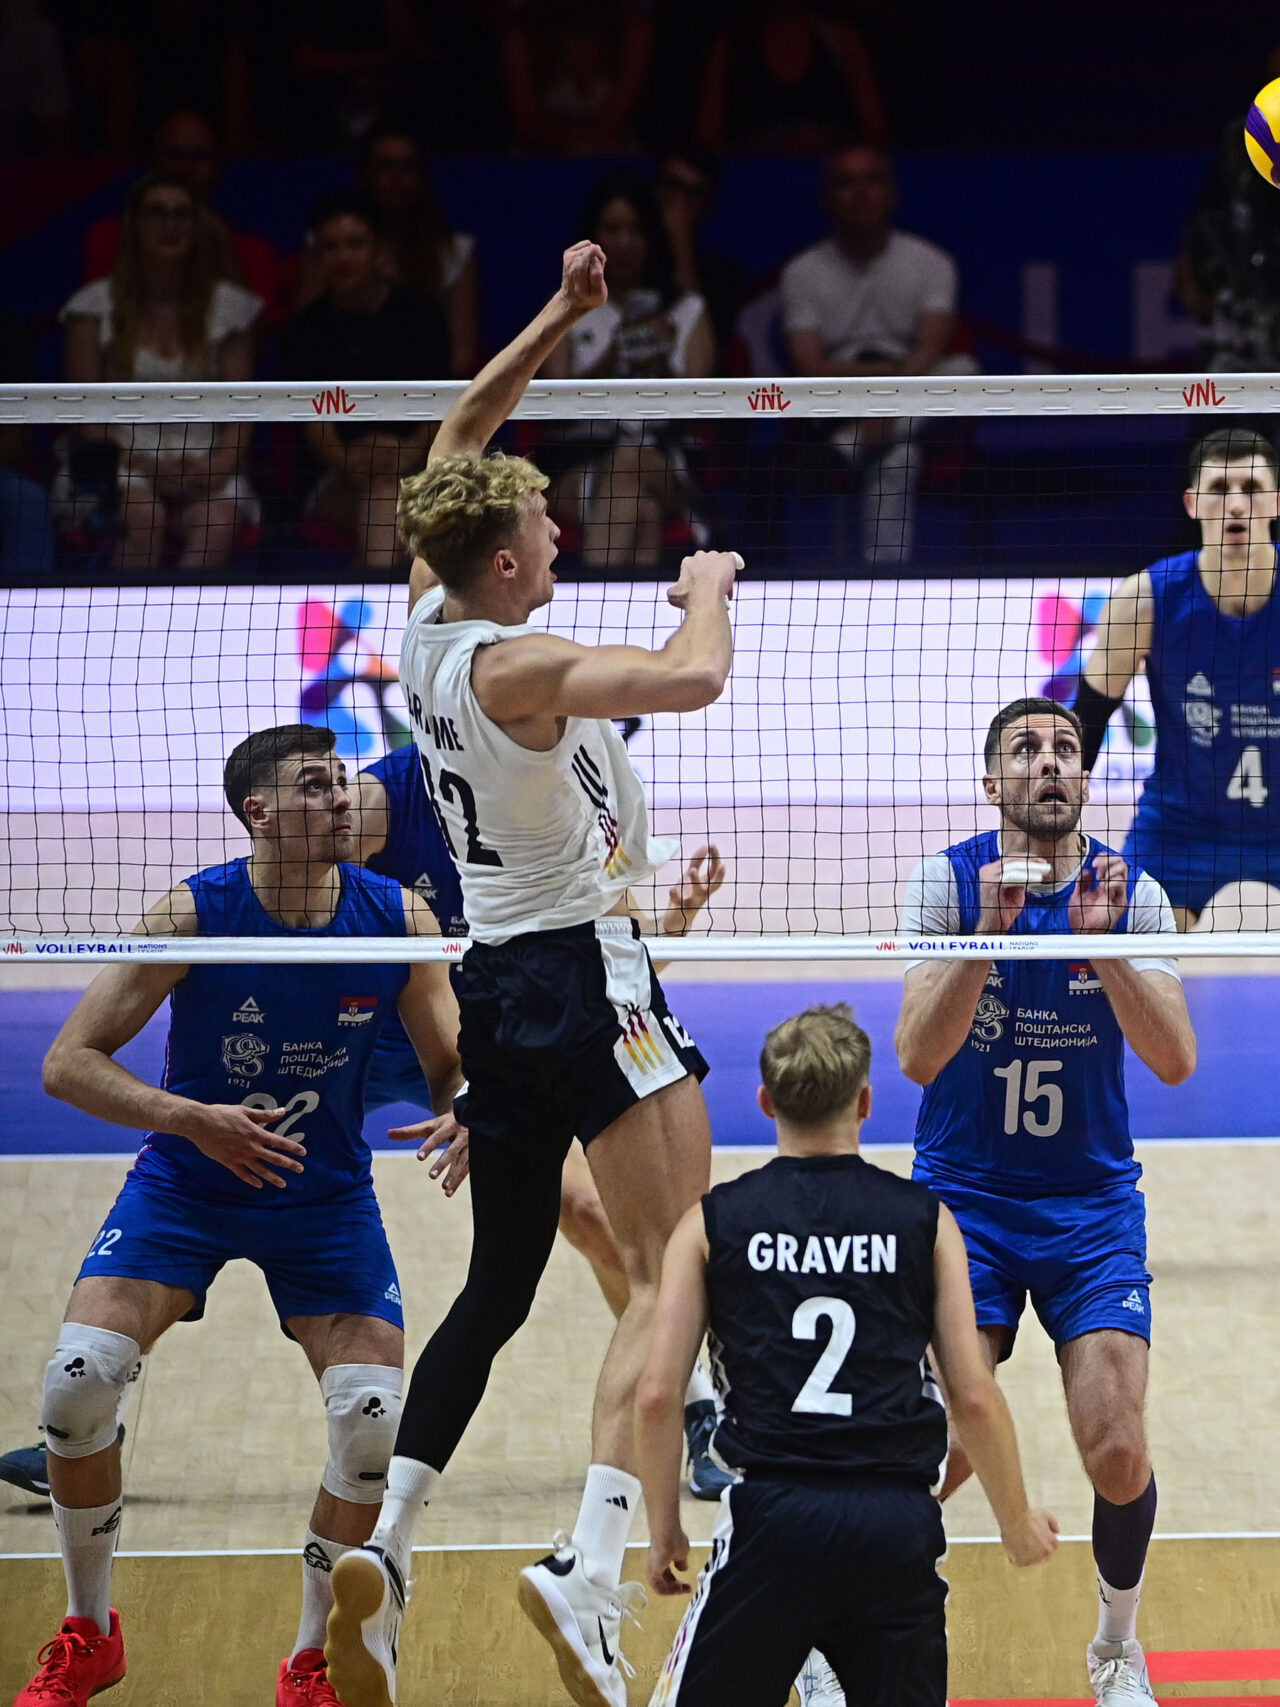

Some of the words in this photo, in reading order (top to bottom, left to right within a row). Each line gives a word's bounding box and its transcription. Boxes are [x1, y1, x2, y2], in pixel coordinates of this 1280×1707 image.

[312, 386, 355, 414] VNL
[749, 384, 791, 410] VNL
[1183, 379, 1226, 407] VNL
[1226, 745, 1268, 808] 4
[36, 943, 135, 954] VOLLEYBALL
[909, 942, 1005, 951] VOLLEYBALL
[232, 1012, 266, 1024] PEAK
[1016, 1007, 1058, 1020] БАНКА
[1015, 1021, 1092, 1034] ПОШТАНСКА
[282, 1041, 323, 1052] БАНКА
[1014, 1036, 1098, 1049] ШТЕДИОНИЦА
[280, 1046, 347, 1065] ПОШТАНКА
[227, 1077, 250, 1089] 1921
[993, 1059, 1063, 1137] 15
[747, 1232, 897, 1274] GRAVEN
[1122, 1300, 1146, 1315] PEAK
[791, 1296, 857, 1417] 2
